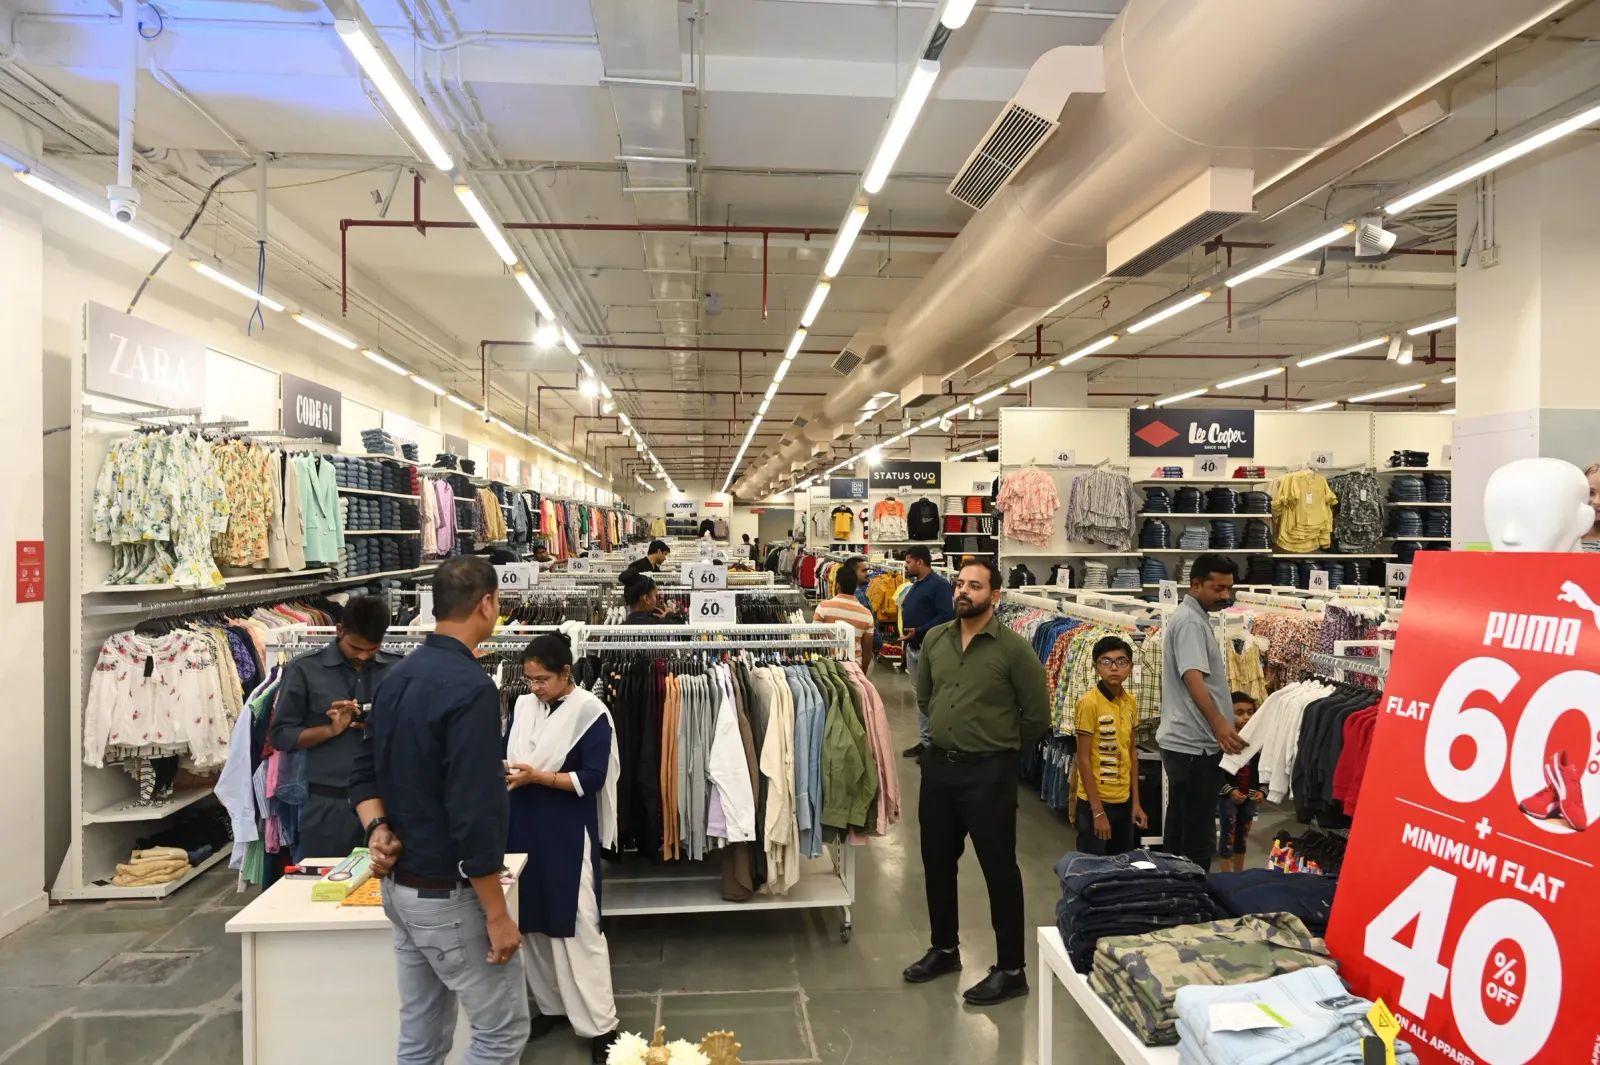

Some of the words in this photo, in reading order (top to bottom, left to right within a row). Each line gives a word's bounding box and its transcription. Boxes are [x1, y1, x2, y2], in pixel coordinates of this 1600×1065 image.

[109, 333, 191, 393] ZARA
[296, 394, 321, 429] CODE
[322, 401, 333, 431] 61
[1188, 422, 1206, 444] Lee
[1208, 422, 1247, 448] Cooper
[873, 471, 911, 480] STATUS
[913, 472, 936, 481] QUO
[1483, 611, 1582, 656] PUMA
[1386, 695, 1430, 721] FLAT
[1424, 656, 1600, 834] 60
[1401, 823, 1497, 878] MINIMUM
[1500, 860, 1565, 903] FLAT
[1363, 865, 1562, 1065] 40
[1493, 951, 1517, 987] %
[1485, 981, 1519, 1007] OFF
[1394, 1013, 1409, 1030] ON
[1409, 1023, 1428, 1043] ALL
